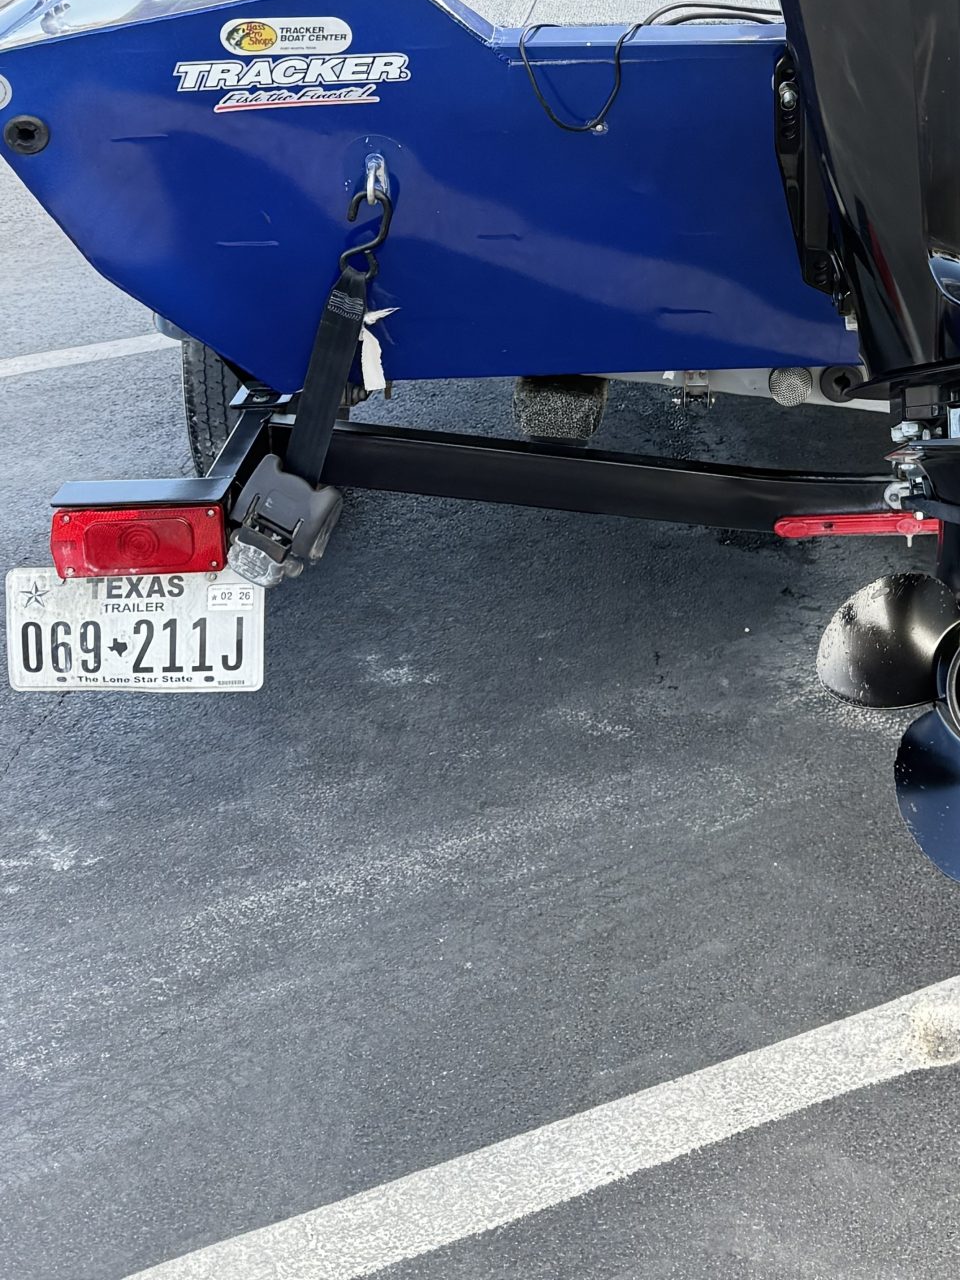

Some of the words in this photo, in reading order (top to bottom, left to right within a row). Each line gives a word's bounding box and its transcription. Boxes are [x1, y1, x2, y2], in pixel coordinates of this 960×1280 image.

[280, 27, 324, 35] TRACKER
[248, 37, 274, 46] Shops
[223, 93, 263, 105] Fish
[265, 91, 293, 102] the
[86, 576, 185, 600] TEXAS
[221, 592, 233, 601] 02
[239, 592, 251, 601] 26
[103, 602, 165, 614] TRAILER
[21, 621, 102, 673] 069
[132, 616, 244, 673] 211J
[162, 675, 193, 683] State
